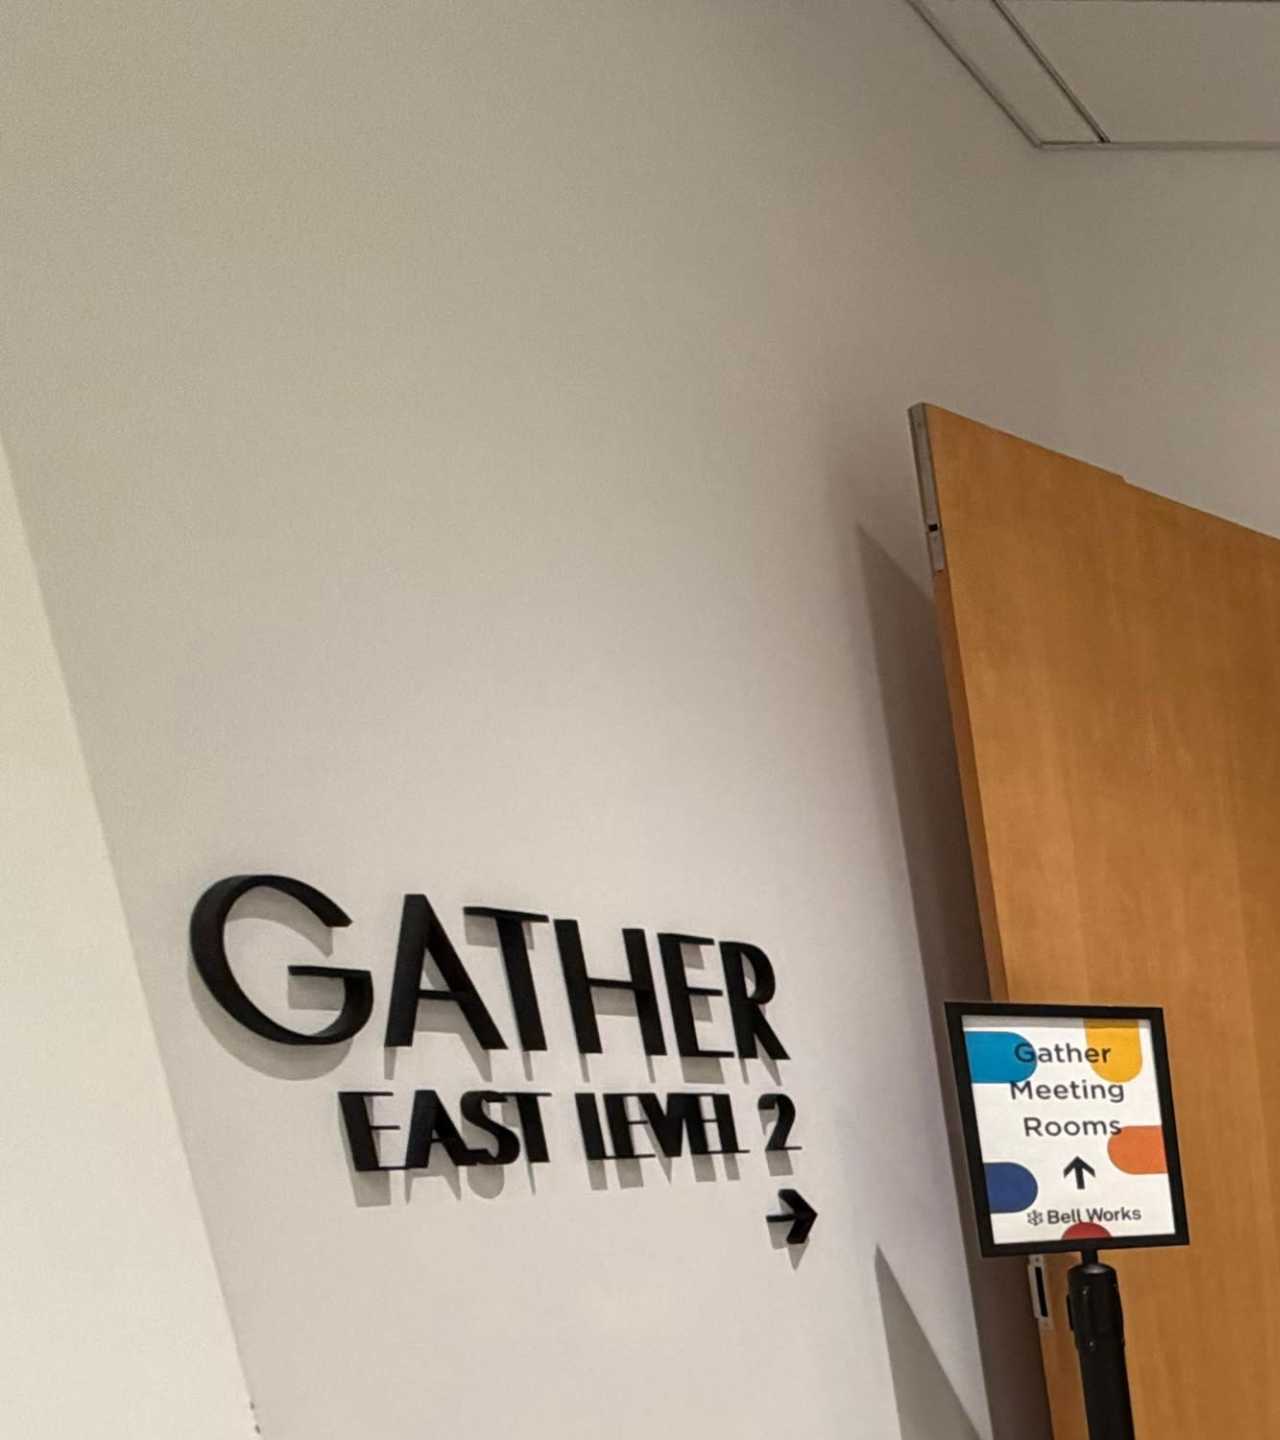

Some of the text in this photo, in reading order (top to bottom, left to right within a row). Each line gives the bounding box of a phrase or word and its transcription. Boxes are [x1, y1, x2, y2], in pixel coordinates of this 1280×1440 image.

[190, 874, 791, 1060] GATHER
[1014, 1042, 1112, 1063] Gather
[1010, 1079, 1124, 1103] Meeting
[337, 1090, 802, 1171] EAST LEVEL 2
[1023, 1117, 1122, 1137] Rooms
[1046, 1206, 1142, 1224] Bell Works
